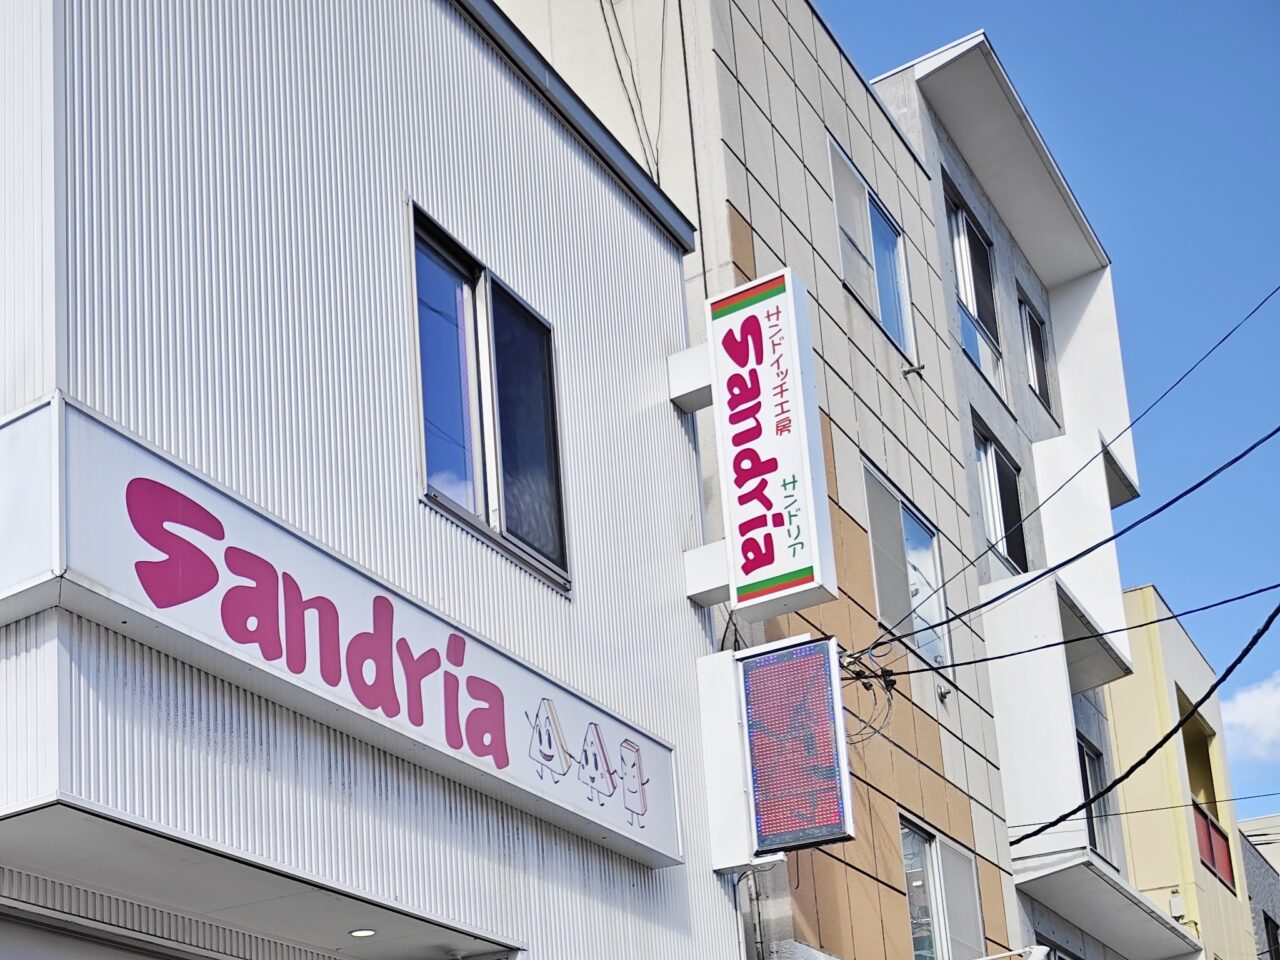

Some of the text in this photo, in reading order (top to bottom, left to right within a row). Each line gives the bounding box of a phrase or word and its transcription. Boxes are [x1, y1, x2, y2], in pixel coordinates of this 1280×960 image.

[721, 314, 785, 577] Sandria
[764, 305, 792, 436] サンドイッチ工房
[780, 474, 804, 558] サンドリア
[125, 477, 509, 769] Sandria
